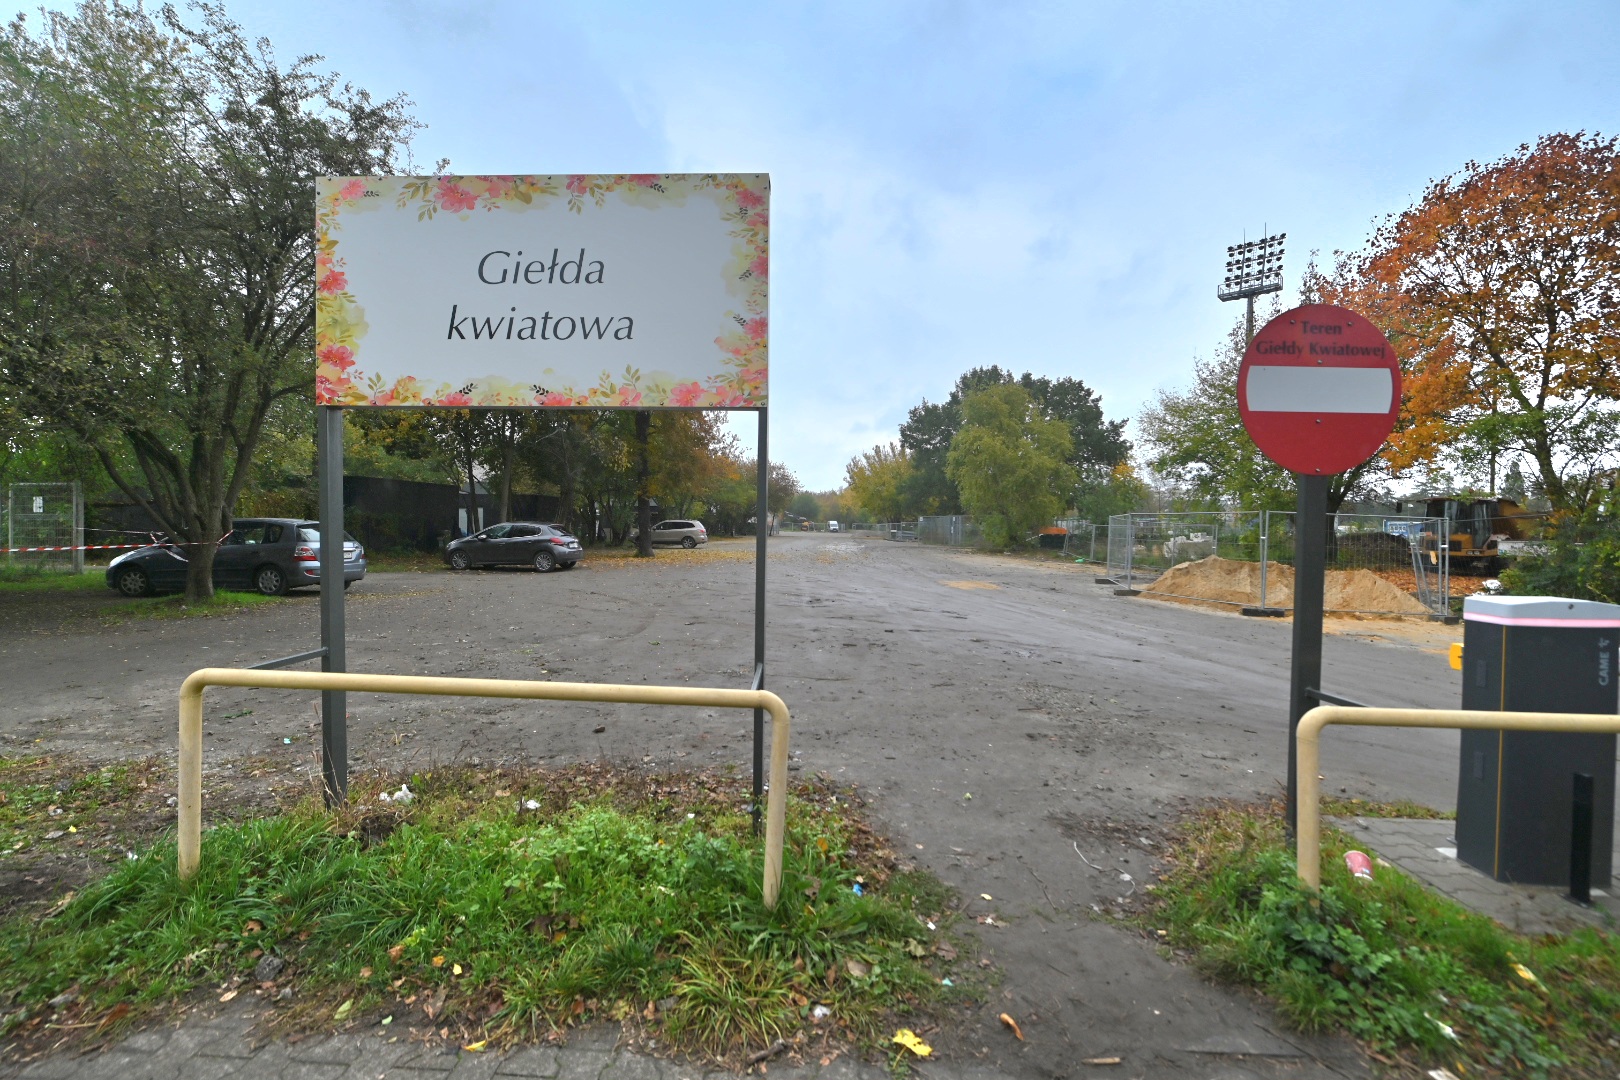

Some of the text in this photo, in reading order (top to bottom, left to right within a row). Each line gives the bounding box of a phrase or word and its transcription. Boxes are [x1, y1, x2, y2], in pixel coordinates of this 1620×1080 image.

[477, 248, 605, 285] Giełda
[447, 304, 634, 341] kwiatowa
[1301, 320, 1343, 335] Teren
[1256, 340, 1387, 359] Giełdy Kwiatowej
[1598, 651, 1610, 686] CAME
